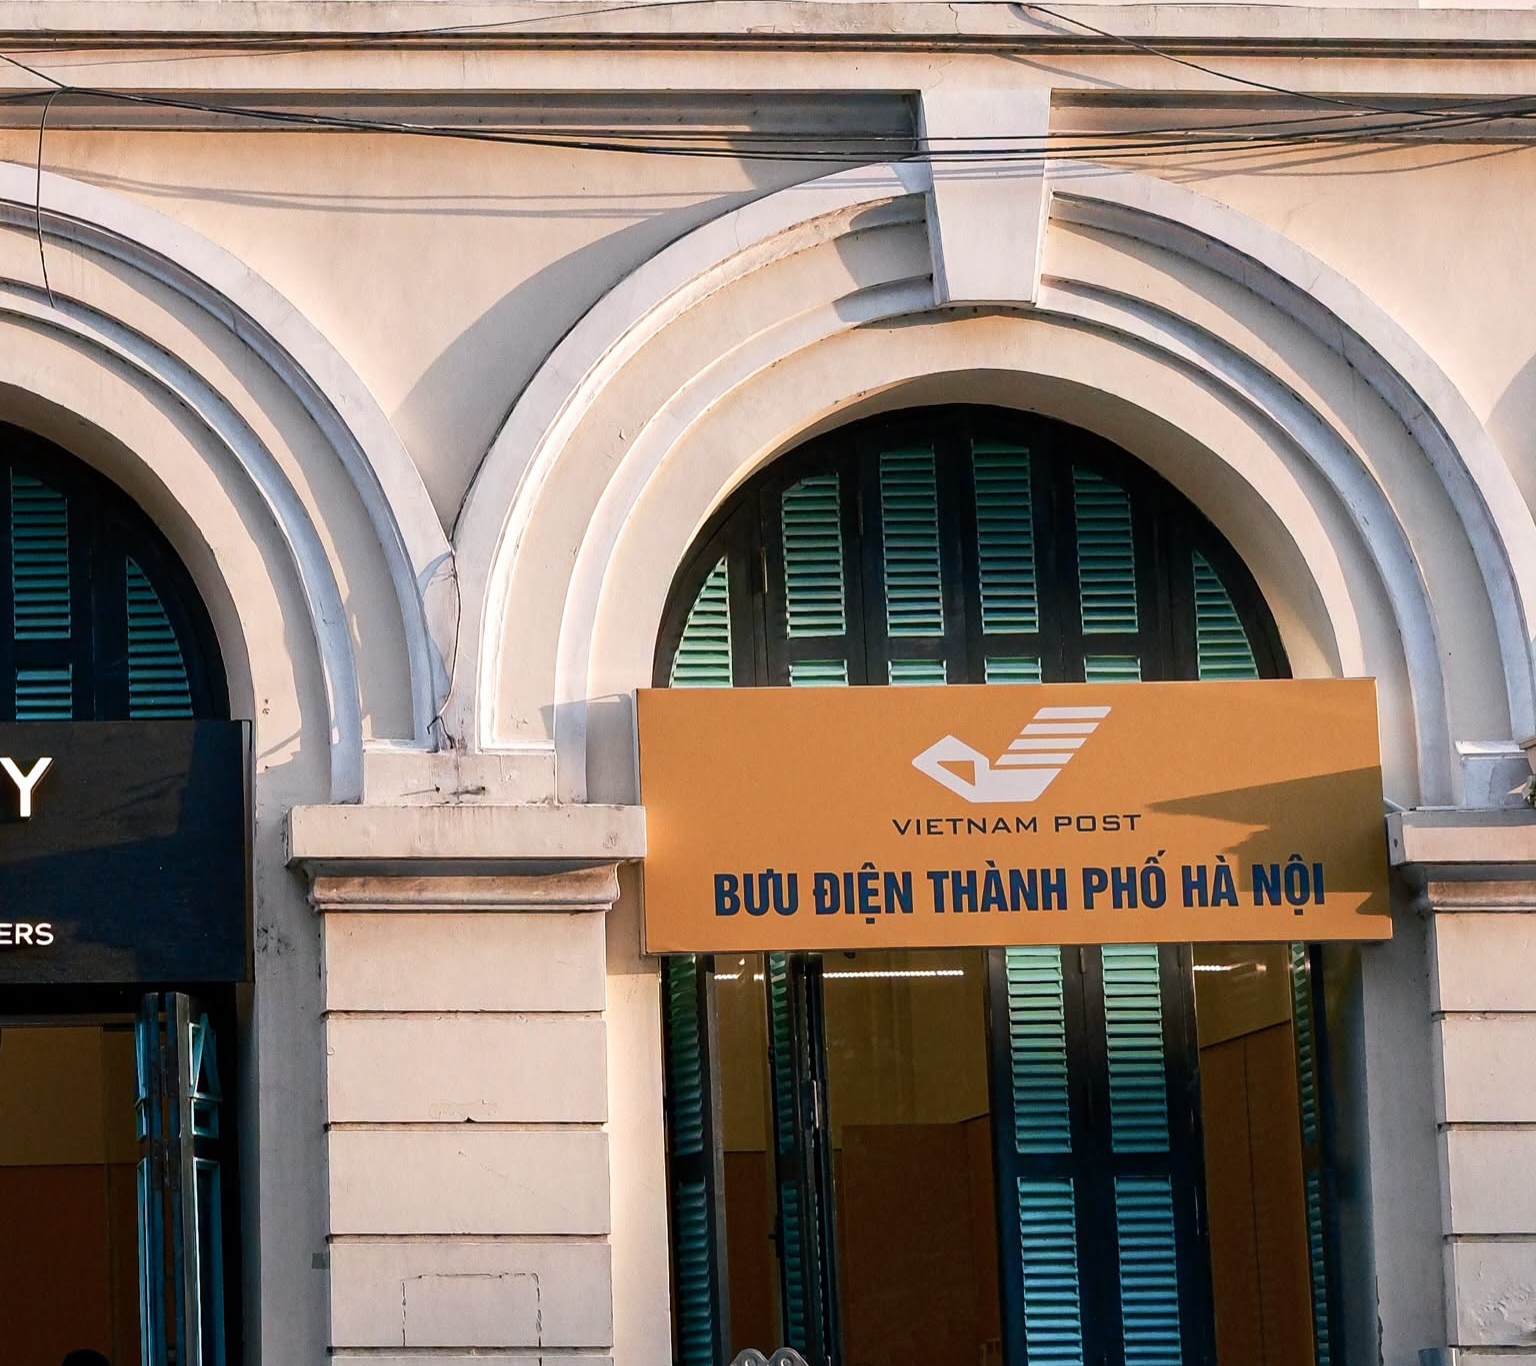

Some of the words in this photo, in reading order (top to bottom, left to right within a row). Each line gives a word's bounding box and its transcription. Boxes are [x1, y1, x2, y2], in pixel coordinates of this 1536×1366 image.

[893, 818, 1036, 834] VIETNAM
[1055, 815, 1140, 831] POST
[715, 869, 798, 916] BƯU
[813, 863, 913, 923] ĐIỆN
[927, 861, 1067, 912] THÀNH
[1083, 850, 1167, 909] PHỐ
[1182, 856, 1238, 907] HÀ
[1254, 854, 1326, 915] NỘI
